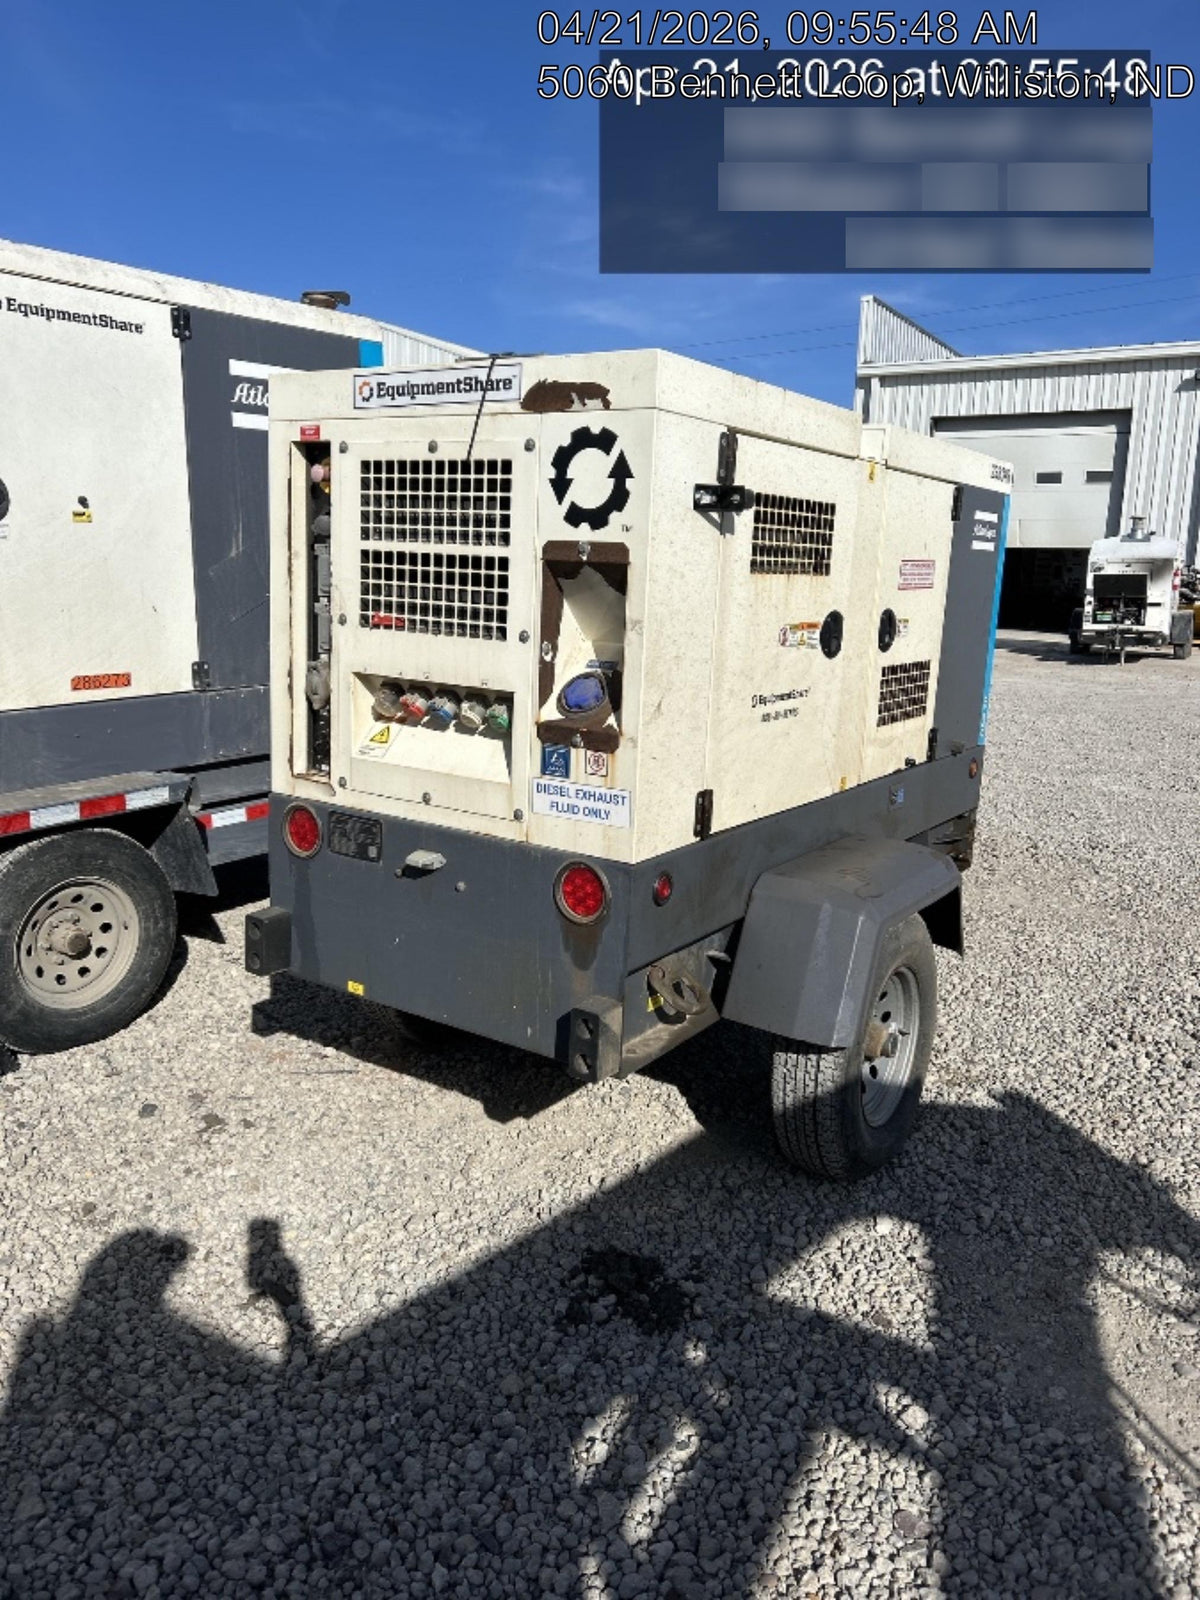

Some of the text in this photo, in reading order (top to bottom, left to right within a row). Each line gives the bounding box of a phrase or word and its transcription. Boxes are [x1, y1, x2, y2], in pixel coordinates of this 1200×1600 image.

[5, 296, 144, 334] EquipmentShare
[376, 376, 513, 400] EquipmentShare
[536, 782, 627, 806] DIESEL EXHAUST
[550, 801, 611, 820] FLUID ONLY
